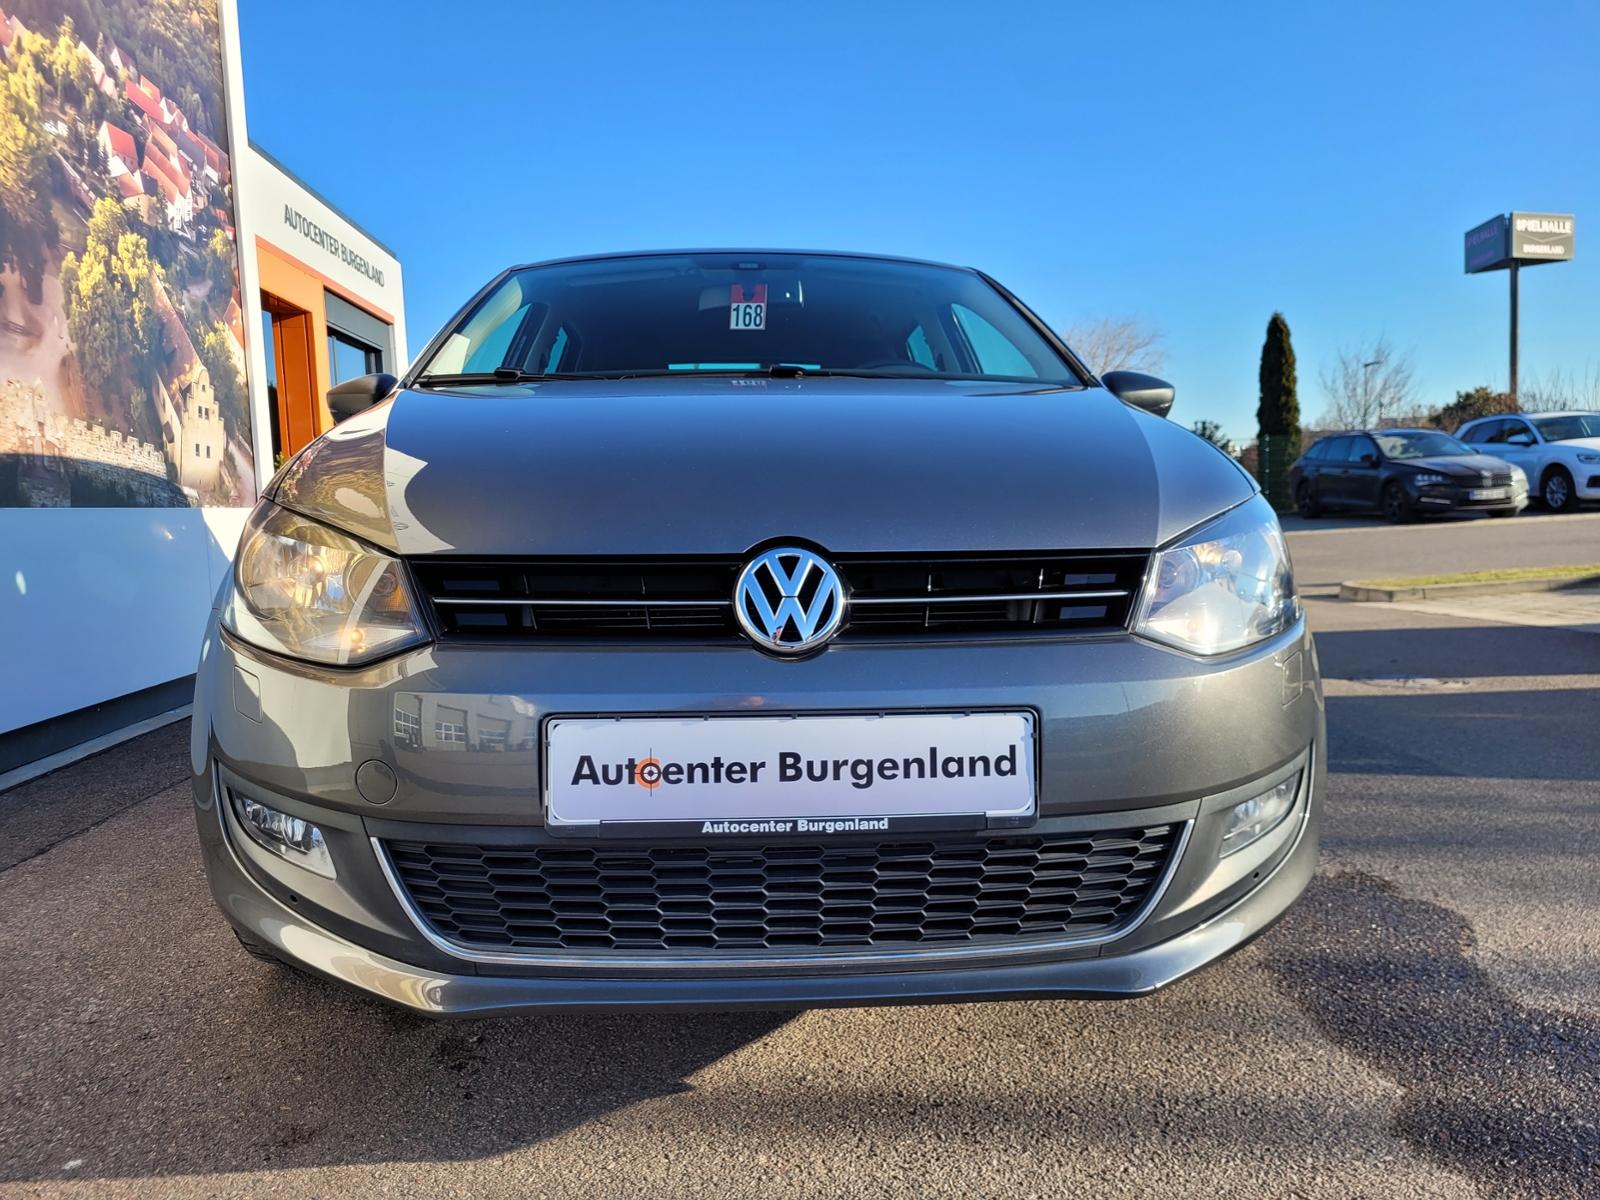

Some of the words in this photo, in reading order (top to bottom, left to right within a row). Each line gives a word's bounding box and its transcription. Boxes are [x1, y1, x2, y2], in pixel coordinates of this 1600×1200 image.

[1515, 218, 1572, 234] SPIELHALLE
[284, 204, 340, 259] AUTOCENTER
[340, 244, 385, 287] BURGENLAND
[732, 304, 763, 328] 168
[778, 745, 1017, 790] Burgenland
[701, 820, 793, 833] Autocenter
[796, 818, 889, 833] Burgenland
